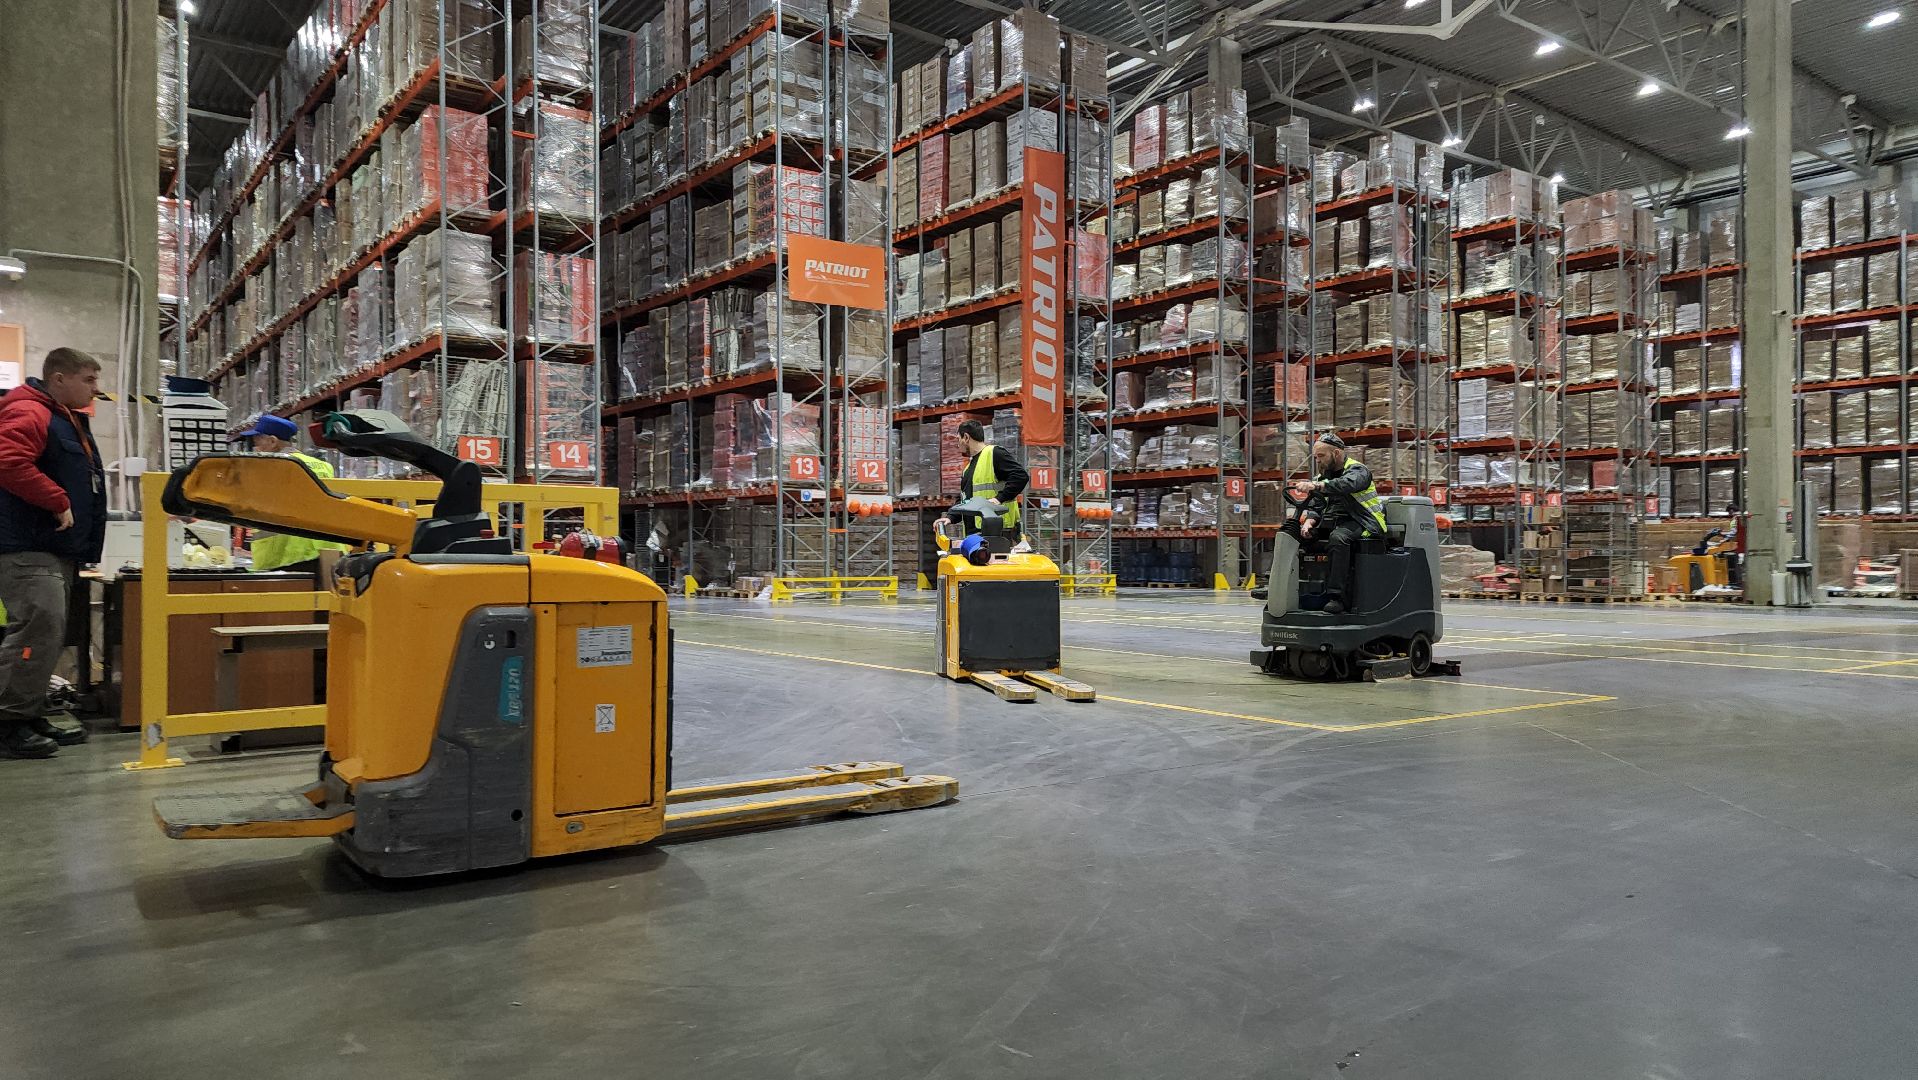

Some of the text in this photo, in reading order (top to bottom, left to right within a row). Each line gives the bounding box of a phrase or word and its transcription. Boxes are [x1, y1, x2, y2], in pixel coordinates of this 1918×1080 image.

[805, 258, 871, 279] PATRIOT
[1032, 181, 1058, 413] PATRIOT
[466, 439, 493, 460] 15
[557, 444, 581, 464] 14
[795, 457, 814, 475] 13
[861, 461, 880, 478] 12
[1037, 469, 1049, 485] 11
[1086, 472, 1101, 487] 10
[1231, 480, 1240, 494] 9
[1405, 487, 1413, 496] 7
[1434, 489, 1442, 501] 6
[1524, 493, 1532, 505] 5
[1550, 493, 1558, 506] 4
